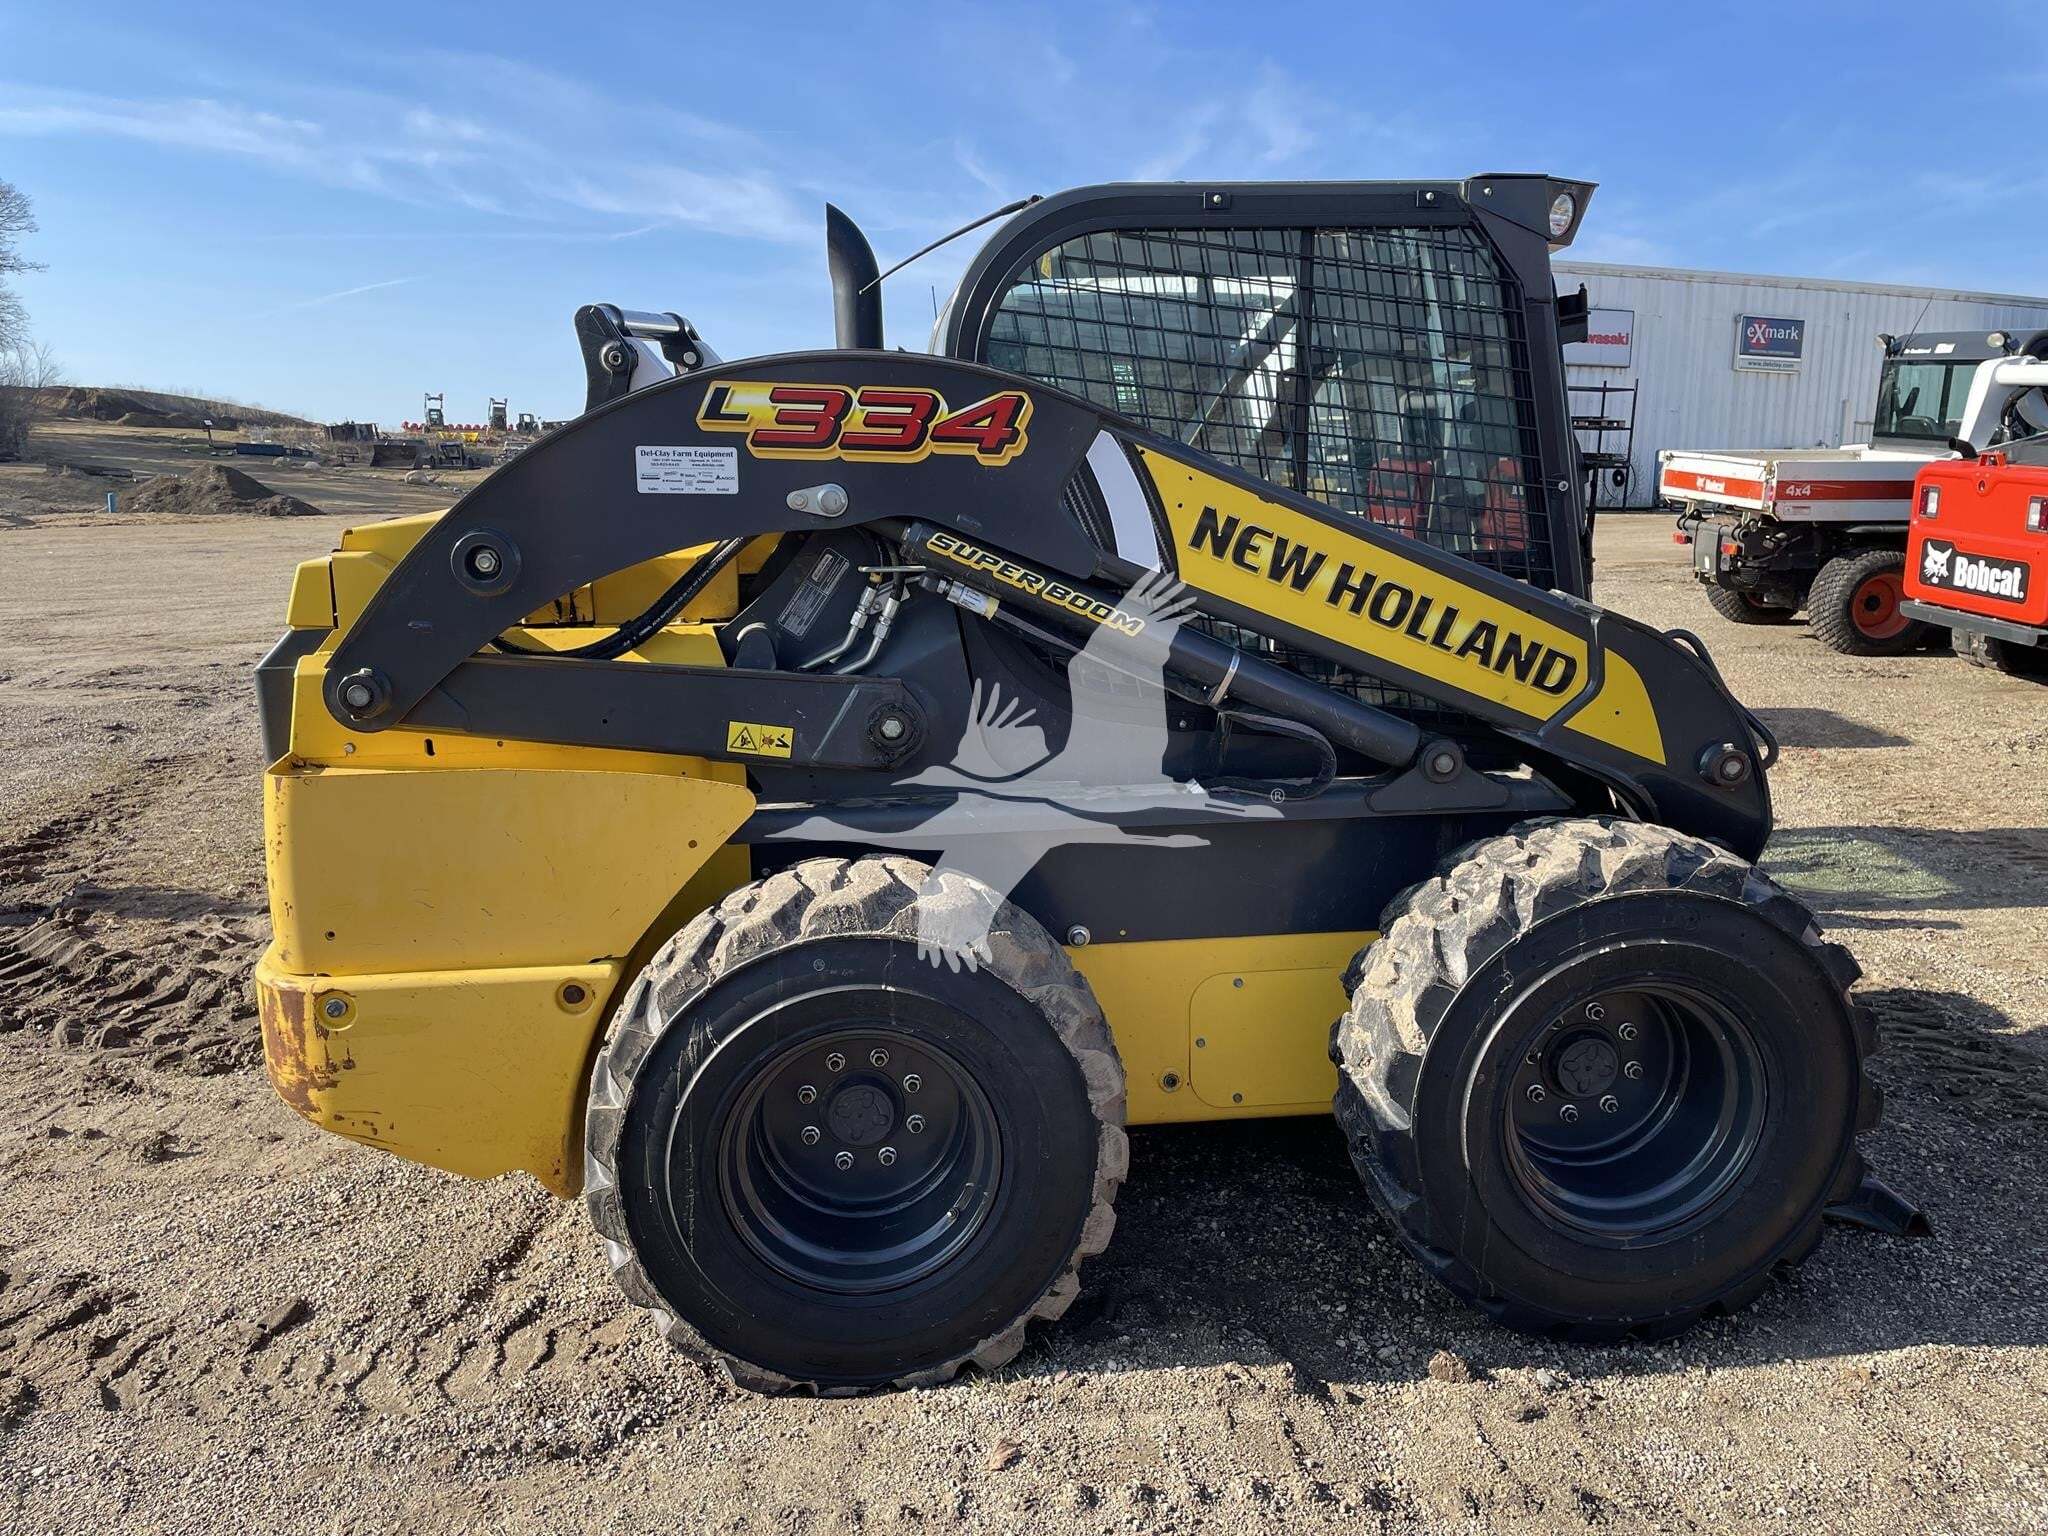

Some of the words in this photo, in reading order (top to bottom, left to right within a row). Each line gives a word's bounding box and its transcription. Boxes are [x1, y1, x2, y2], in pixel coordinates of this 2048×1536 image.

[1588, 332, 1629, 345] wasaki
[640, 449, 671, 458] Del-Clay
[694, 450, 734, 459] Equipment
[1785, 484, 1812, 497] 4x4
[926, 532, 1046, 595] SUPER
[1042, 582, 1145, 637] BOOM
[1188, 505, 1329, 595] NEW
[1326, 561, 1579, 697] HOLLAND
